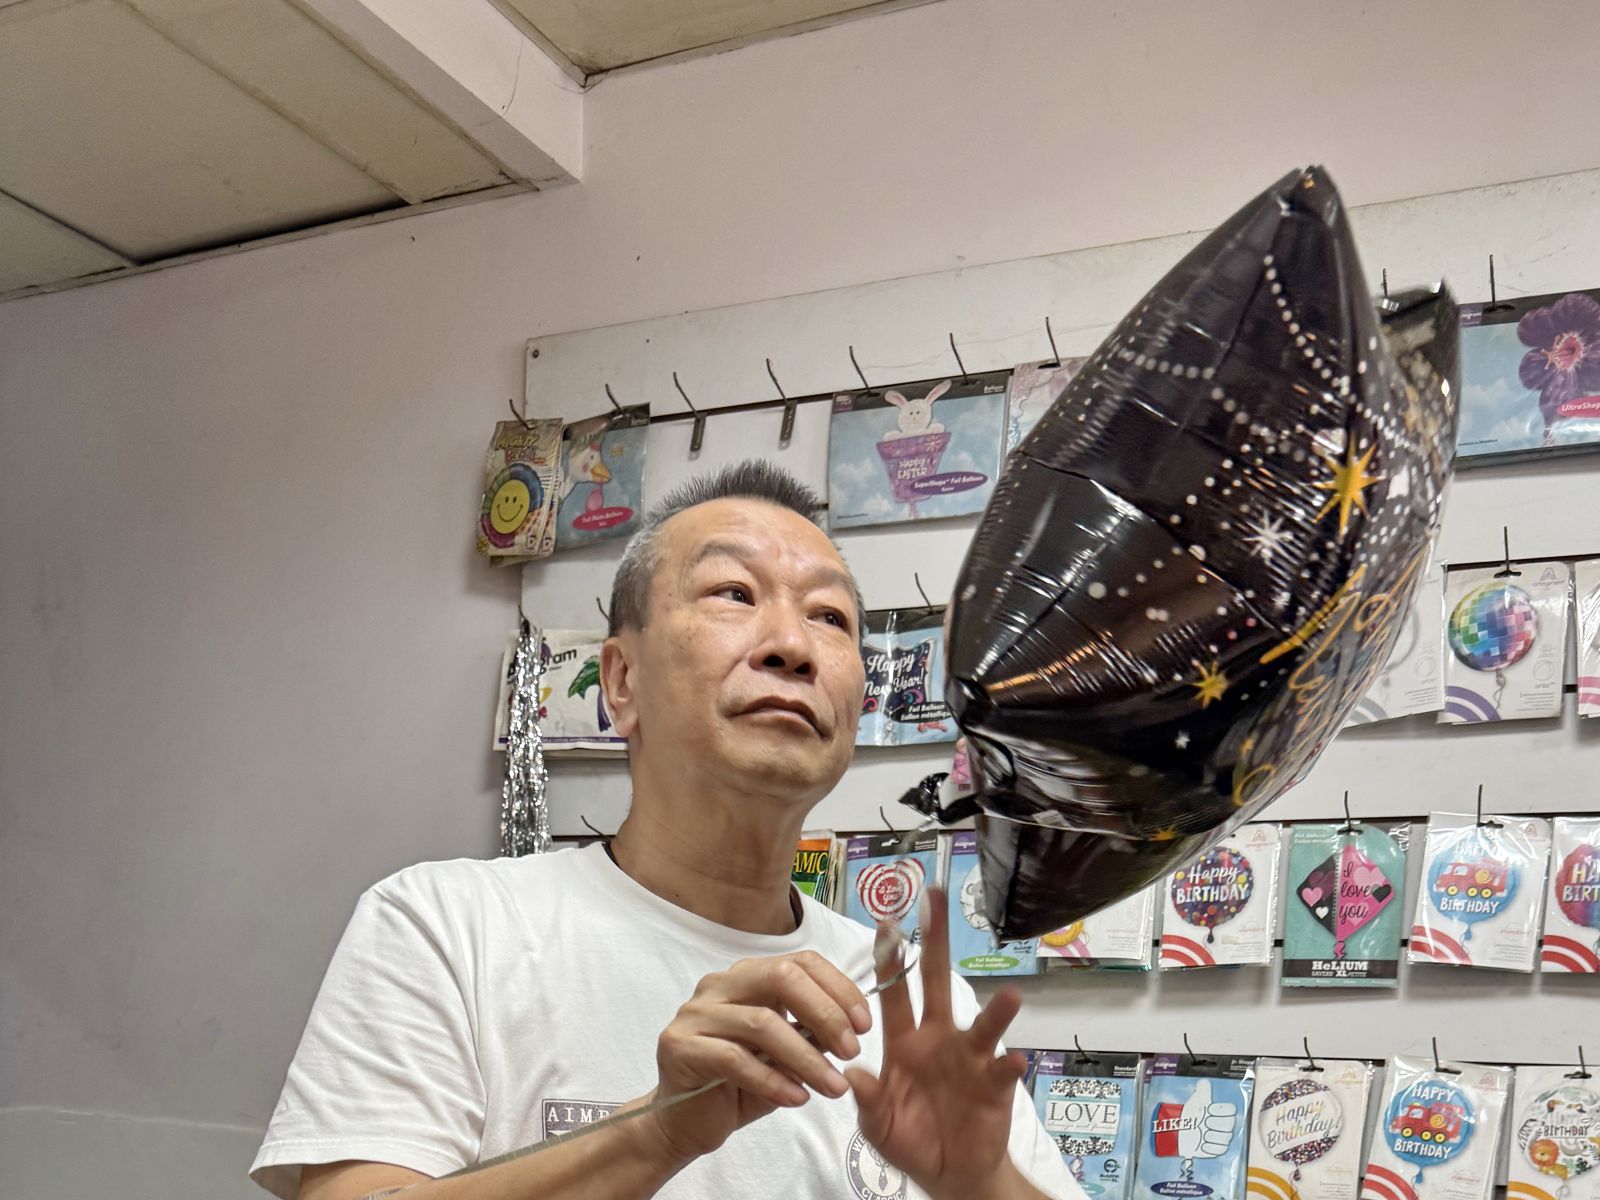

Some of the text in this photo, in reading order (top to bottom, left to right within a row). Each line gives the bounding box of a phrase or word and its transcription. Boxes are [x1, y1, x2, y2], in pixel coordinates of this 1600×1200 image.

[899, 457, 926, 468] HAPPY
[897, 467, 928, 480] EASTER
[867, 653, 916, 677] Happy
[893, 667, 924, 693] Year!
[908, 703, 945, 713] Foil Balloon
[1187, 864, 1241, 884] Happy
[1176, 882, 1249, 904] BIRTHDAY
[1341, 884, 1370, 898] love
[1339, 905, 1369, 925] you
[1440, 897, 1500, 914] BIRTHDAY
[1311, 960, 1369, 971] HeLIUM
[1411, 1084, 1457, 1102] HAPPY
[1048, 1102, 1117, 1125] LOVE
[1276, 1101, 1326, 1126] Happy
[1152, 1117, 1198, 1133] LIKE!
[1267, 1115, 1340, 1148] Birthday!
[1544, 1124, 1590, 1137] BIRTHDAY
[1394, 1138, 1452, 1159] BIRTHDAY
